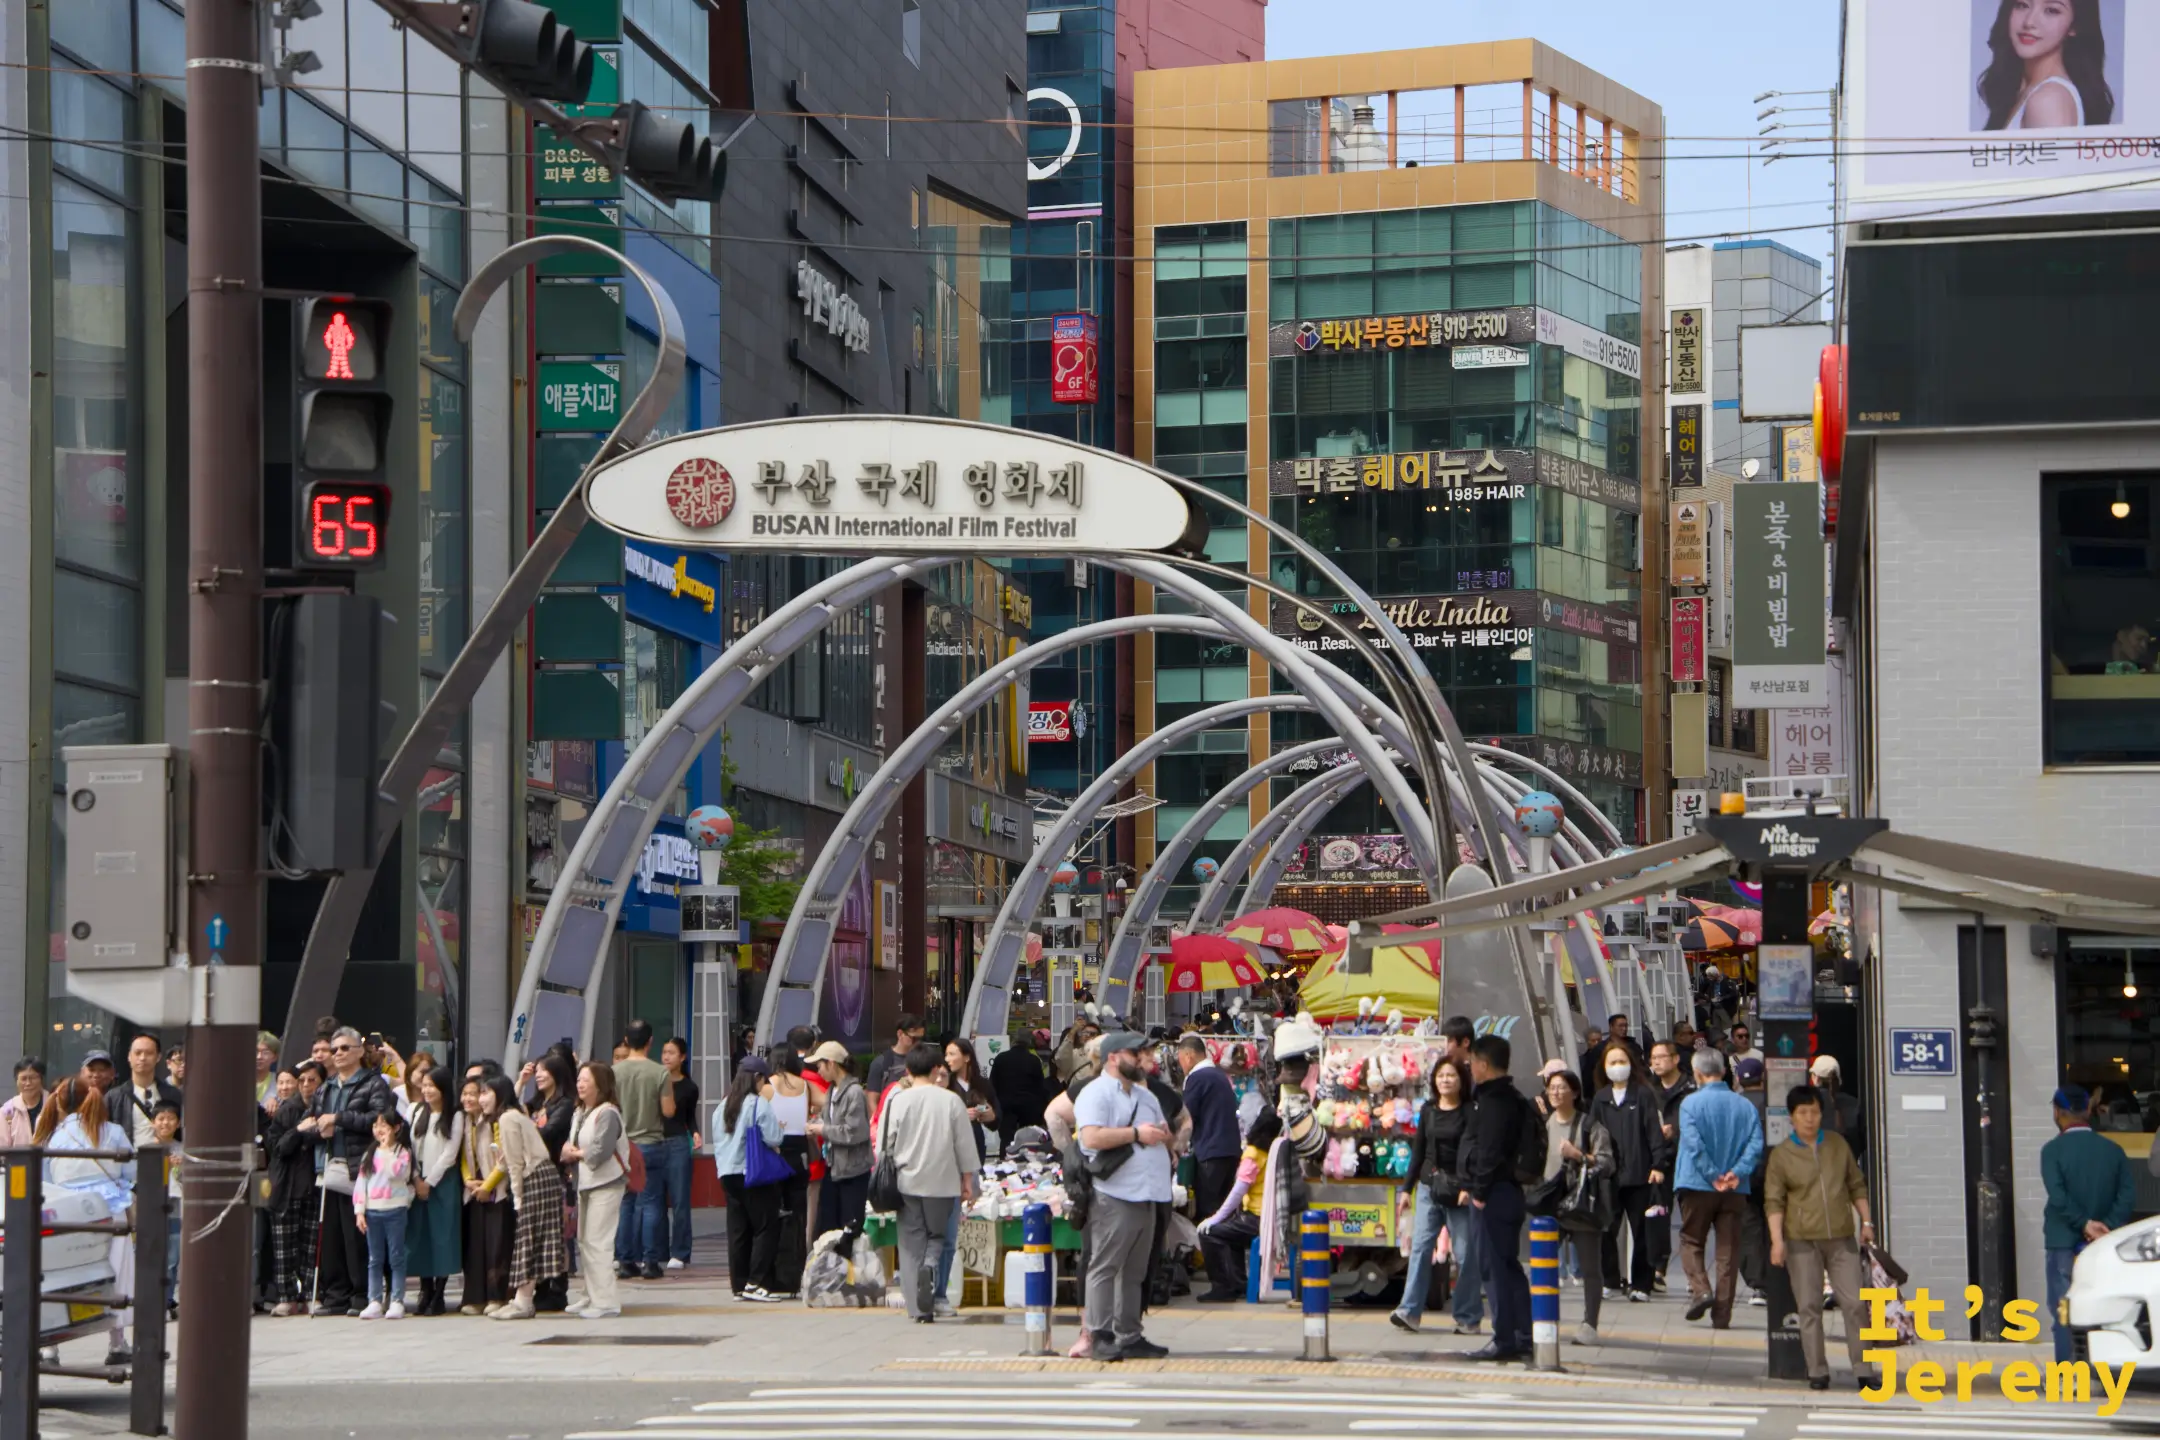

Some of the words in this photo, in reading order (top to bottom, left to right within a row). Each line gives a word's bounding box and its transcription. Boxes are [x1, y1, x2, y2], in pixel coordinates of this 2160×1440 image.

[604, 54, 615, 65] 9F
[544, 167, 576, 183] 피부
[607, 211, 617, 221] 7F
[607, 289, 618, 299] 6F
[1443, 313, 1508, 341] 919-5500
[1674, 326, 1699, 338] 박사
[1541, 313, 1558, 343] 박사
[1599, 337, 1638, 374] 919-5500
[1454, 352, 1483, 365] NAVER
[1677, 338, 1697, 382] 부동산
[605, 364, 619, 375] 5F
[1068, 376, 1083, 389] 6F
[1672, 381, 1701, 390] 919-5500
[544, 382, 617, 418] 애플치과
[1678, 418, 1697, 485] 헤어뉴스
[1294, 449, 1508, 494] 박춘헤어뉴스
[752, 460, 836, 506] 부산
[855, 460, 938, 507] 국제
[962, 460, 1084, 508] 영화제
[1447, 487, 1482, 501] 1985
[1485, 484, 1526, 500] HAIR
[1602, 478, 1618, 498] 1985
[1619, 481, 1637, 504] HAIR
[311, 494, 377, 557] 65
[752, 515, 830, 536] BUSAN
[834, 515, 953, 538] International
[958, 517, 1000, 538] Film
[1003, 517, 1078, 539] Festival
[607, 597, 617, 606] 2F
[1433, 596, 1512, 627] India
[1413, 632, 1440, 647] Bar
[1441, 632, 1458, 648] 뉴
[1460, 627, 1534, 647] 리틀인디아
[1680, 624, 1697, 673] 마라탕
[1750, 680, 1810, 694] 부산남포점
[1785, 724, 1832, 748] 헤어
[1785, 751, 1833, 777] 살롱
[1768, 843, 1817, 857] junggu
[1902, 1043, 1945, 1062] 58-1
[1348, 1208, 1379, 1222] card
